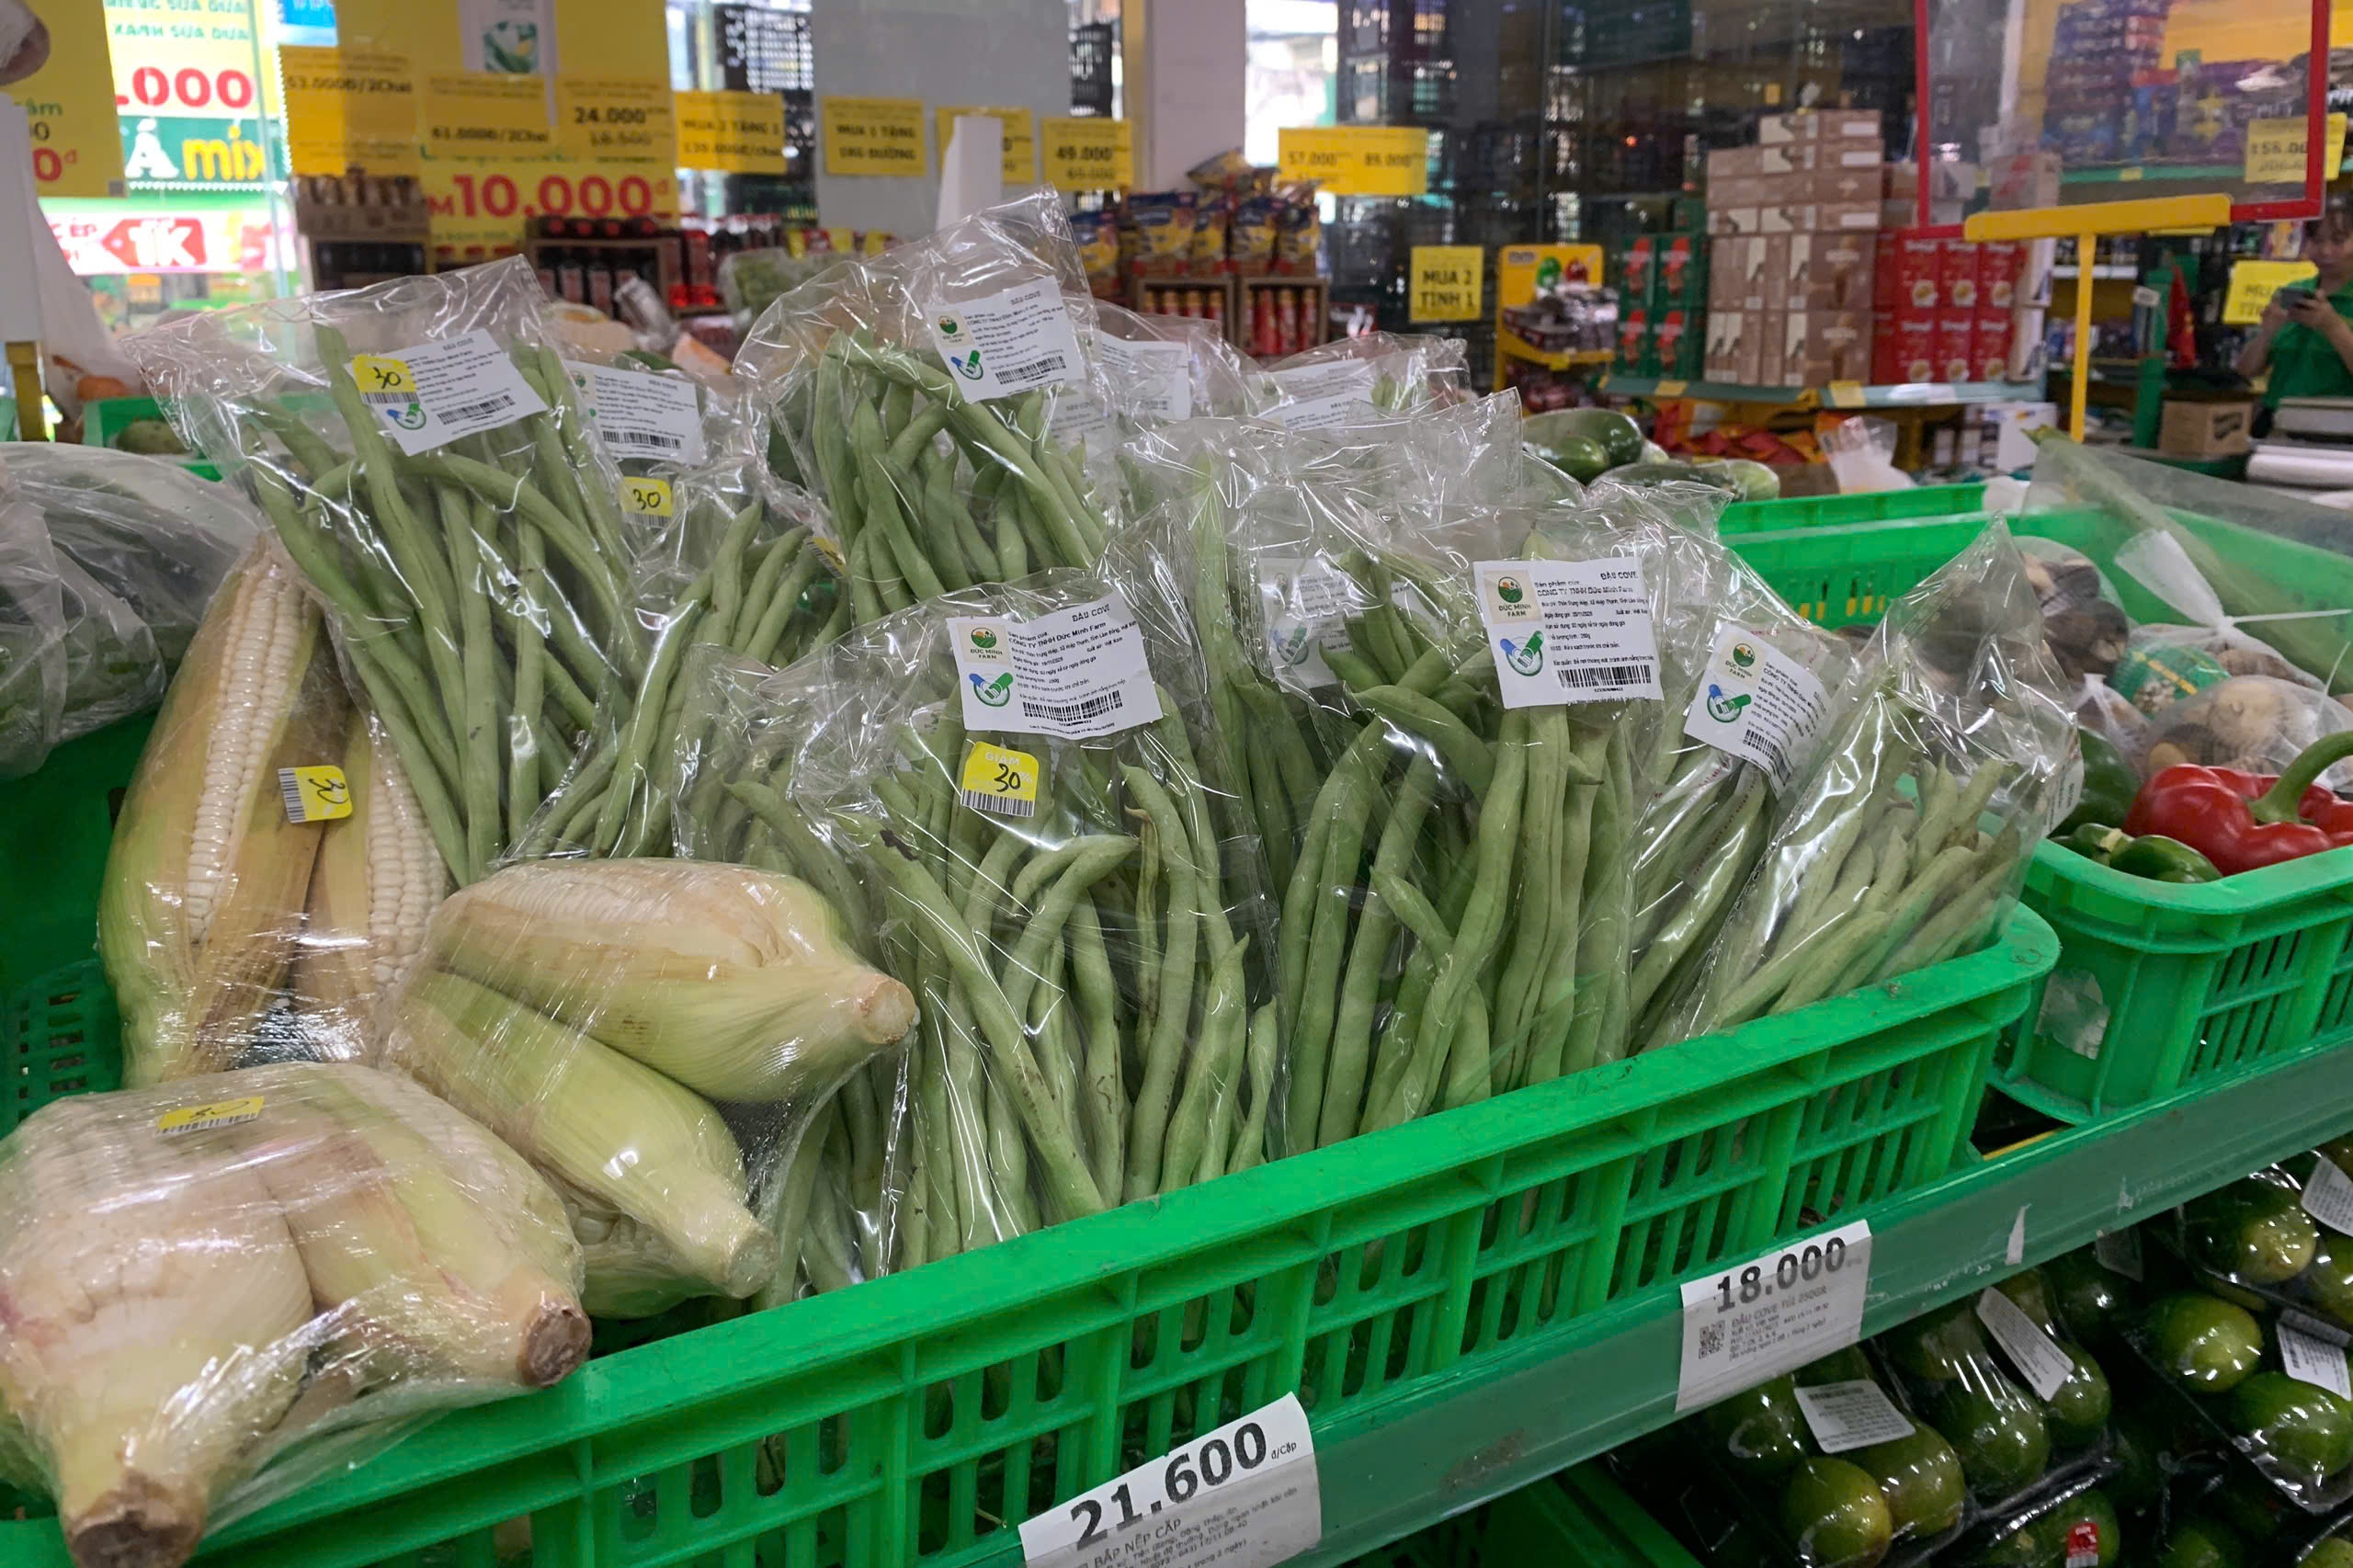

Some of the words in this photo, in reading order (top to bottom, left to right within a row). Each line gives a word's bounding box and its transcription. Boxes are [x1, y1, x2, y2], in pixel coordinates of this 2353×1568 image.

[632, 488, 662, 511] 30
[1618, 571, 1639, 580] COVE
[1091, 603, 1111, 618] COVE
[1072, 627, 1089, 637] Minh
[1089, 622, 1107, 632] Farm
[994, 762, 1021, 792] 30
[1717, 1236, 1847, 1314] 18.000
[1070, 1422, 1267, 1551] 21.600
